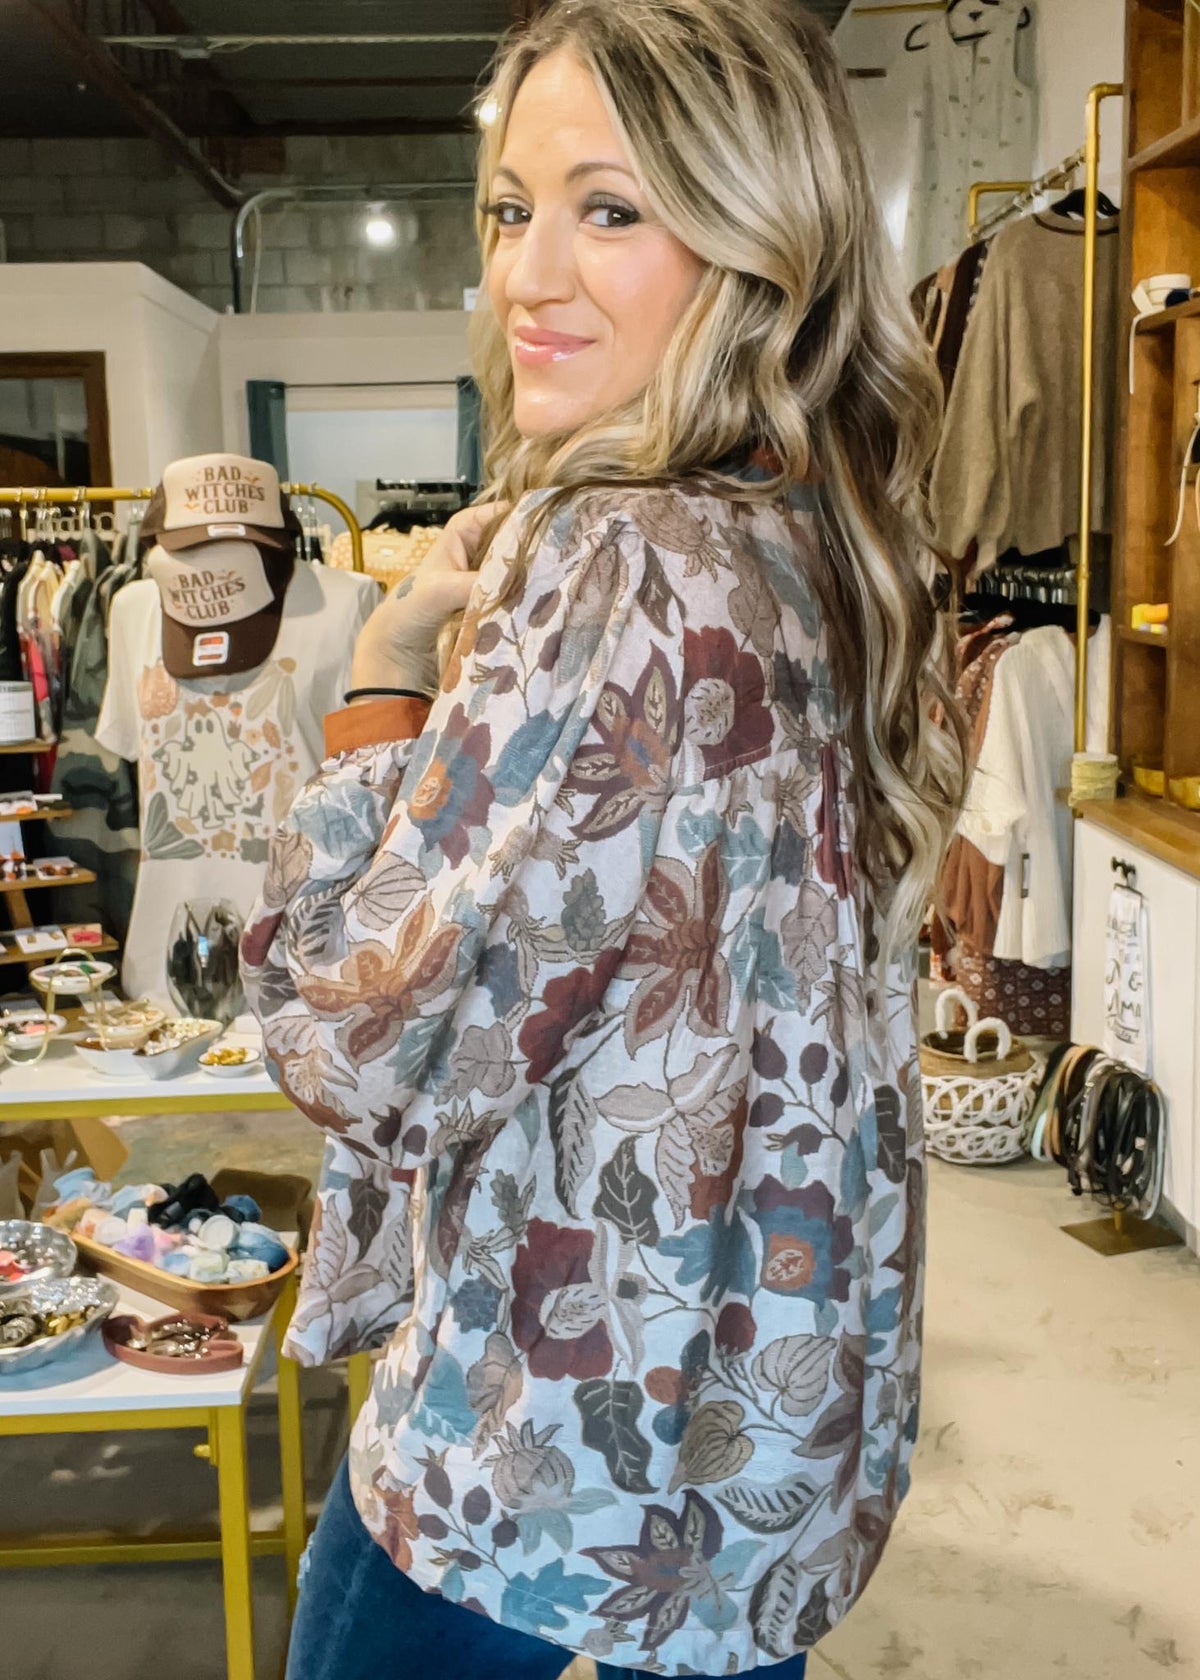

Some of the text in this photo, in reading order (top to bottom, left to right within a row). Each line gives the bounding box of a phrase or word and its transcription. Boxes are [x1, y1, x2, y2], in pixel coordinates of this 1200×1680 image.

[204, 466, 241, 481] BAD
[185, 482, 265, 502] WITCHES
[203, 499, 249, 515] CLUB
[178, 570, 214, 588] BAD
[168, 577, 246, 603] WITCHES
[186, 600, 230, 619] CLUB
